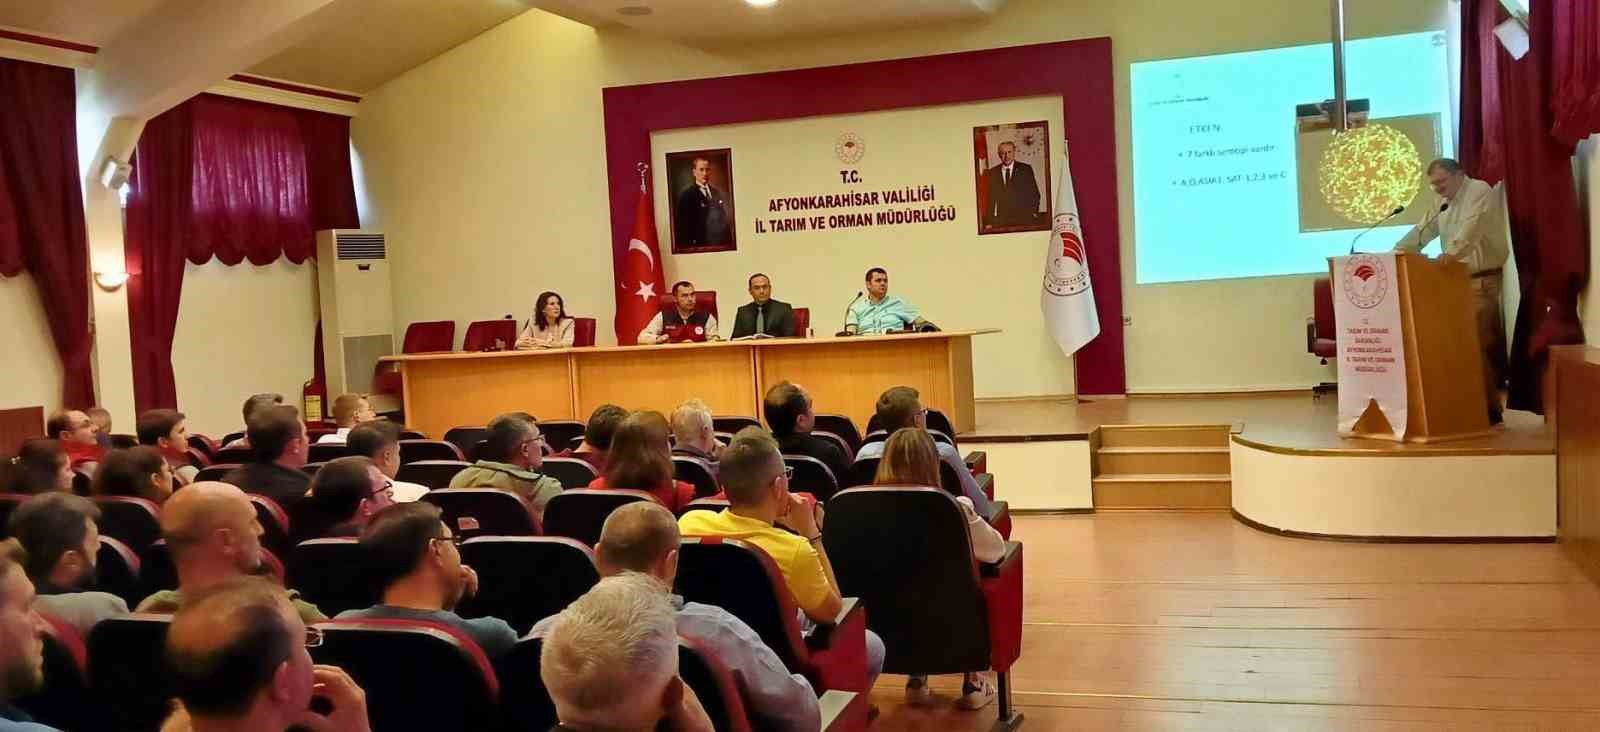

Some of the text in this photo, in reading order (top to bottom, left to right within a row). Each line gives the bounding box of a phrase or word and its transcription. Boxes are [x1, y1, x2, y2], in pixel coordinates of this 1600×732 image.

[840, 170, 862, 184] T.C.
[769, 184, 935, 212] AFYONKARAHİSAR VALİLİĞİ
[755, 205, 956, 234] İL TARIM VE ORMAN MÜDÜRLÜĞÜ
